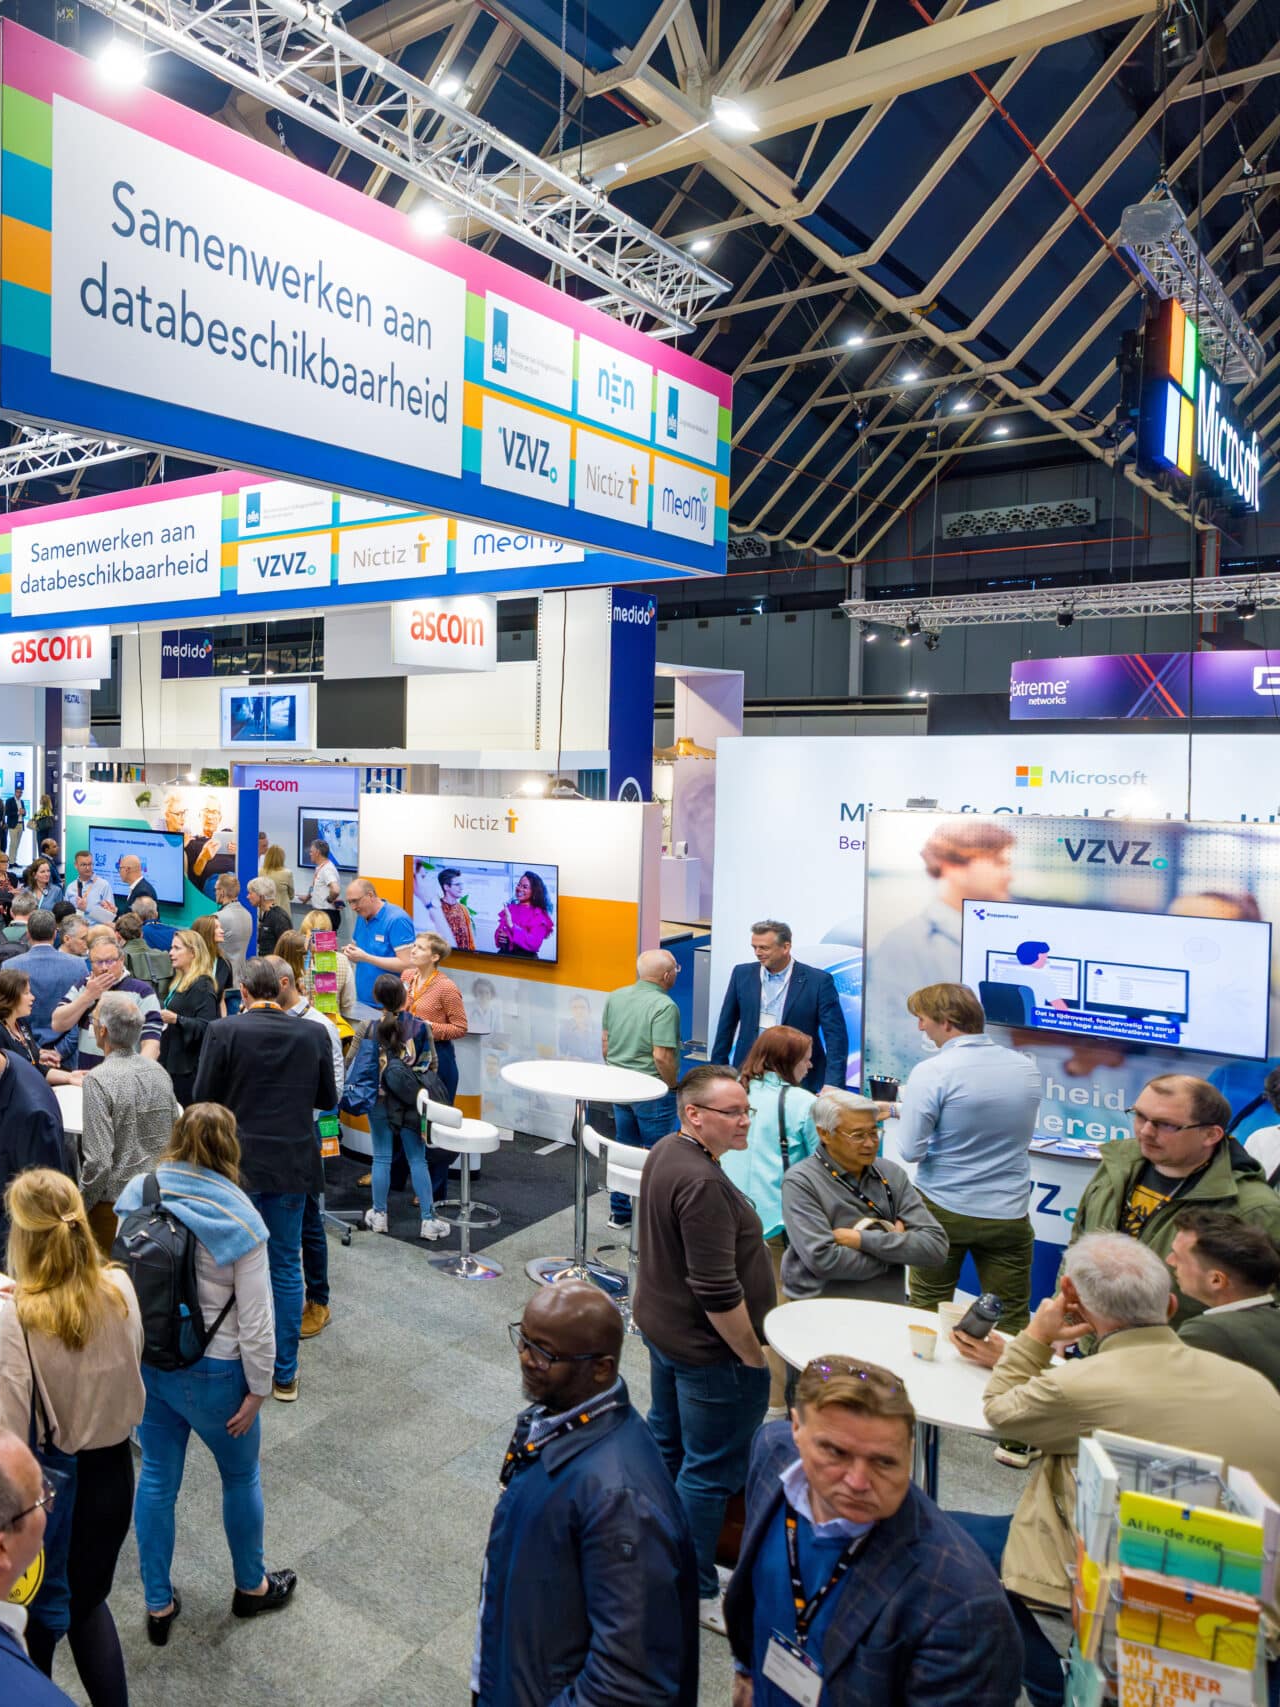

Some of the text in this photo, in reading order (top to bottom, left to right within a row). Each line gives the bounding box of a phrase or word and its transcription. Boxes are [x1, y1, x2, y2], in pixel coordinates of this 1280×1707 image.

[111, 179, 432, 350] Samenwerken aan
[80, 261, 448, 424] databeschikbaarheid
[502, 427, 550, 477] VZVZ
[1197, 367, 1260, 512] Microsoft
[586, 463, 624, 500] Nictiz
[31, 523, 195, 563] Samenwerken aan
[353, 545, 407, 568] Nictiz
[20, 550, 209, 594] databeschikbaarheid
[256, 551, 307, 578] VZVZ
[410, 609, 484, 647] ascom
[613, 605, 651, 625] medido
[11, 634, 92, 664] ascom
[162, 643, 207, 659] medido
[1012, 680, 1068, 696] Extreme
[1028, 696, 1067, 705] networks
[255, 779, 299, 793] ascom
[1049, 769, 1147, 786] Microsoft
[454, 813, 499, 831] Nictiz
[1065, 837, 1151, 866] VZVZ
[1126, 1517, 1224, 1552] AI in de zorg
[1122, 1642, 1159, 1664] WIL
[1122, 1659, 1223, 1695] JIJ MEER
